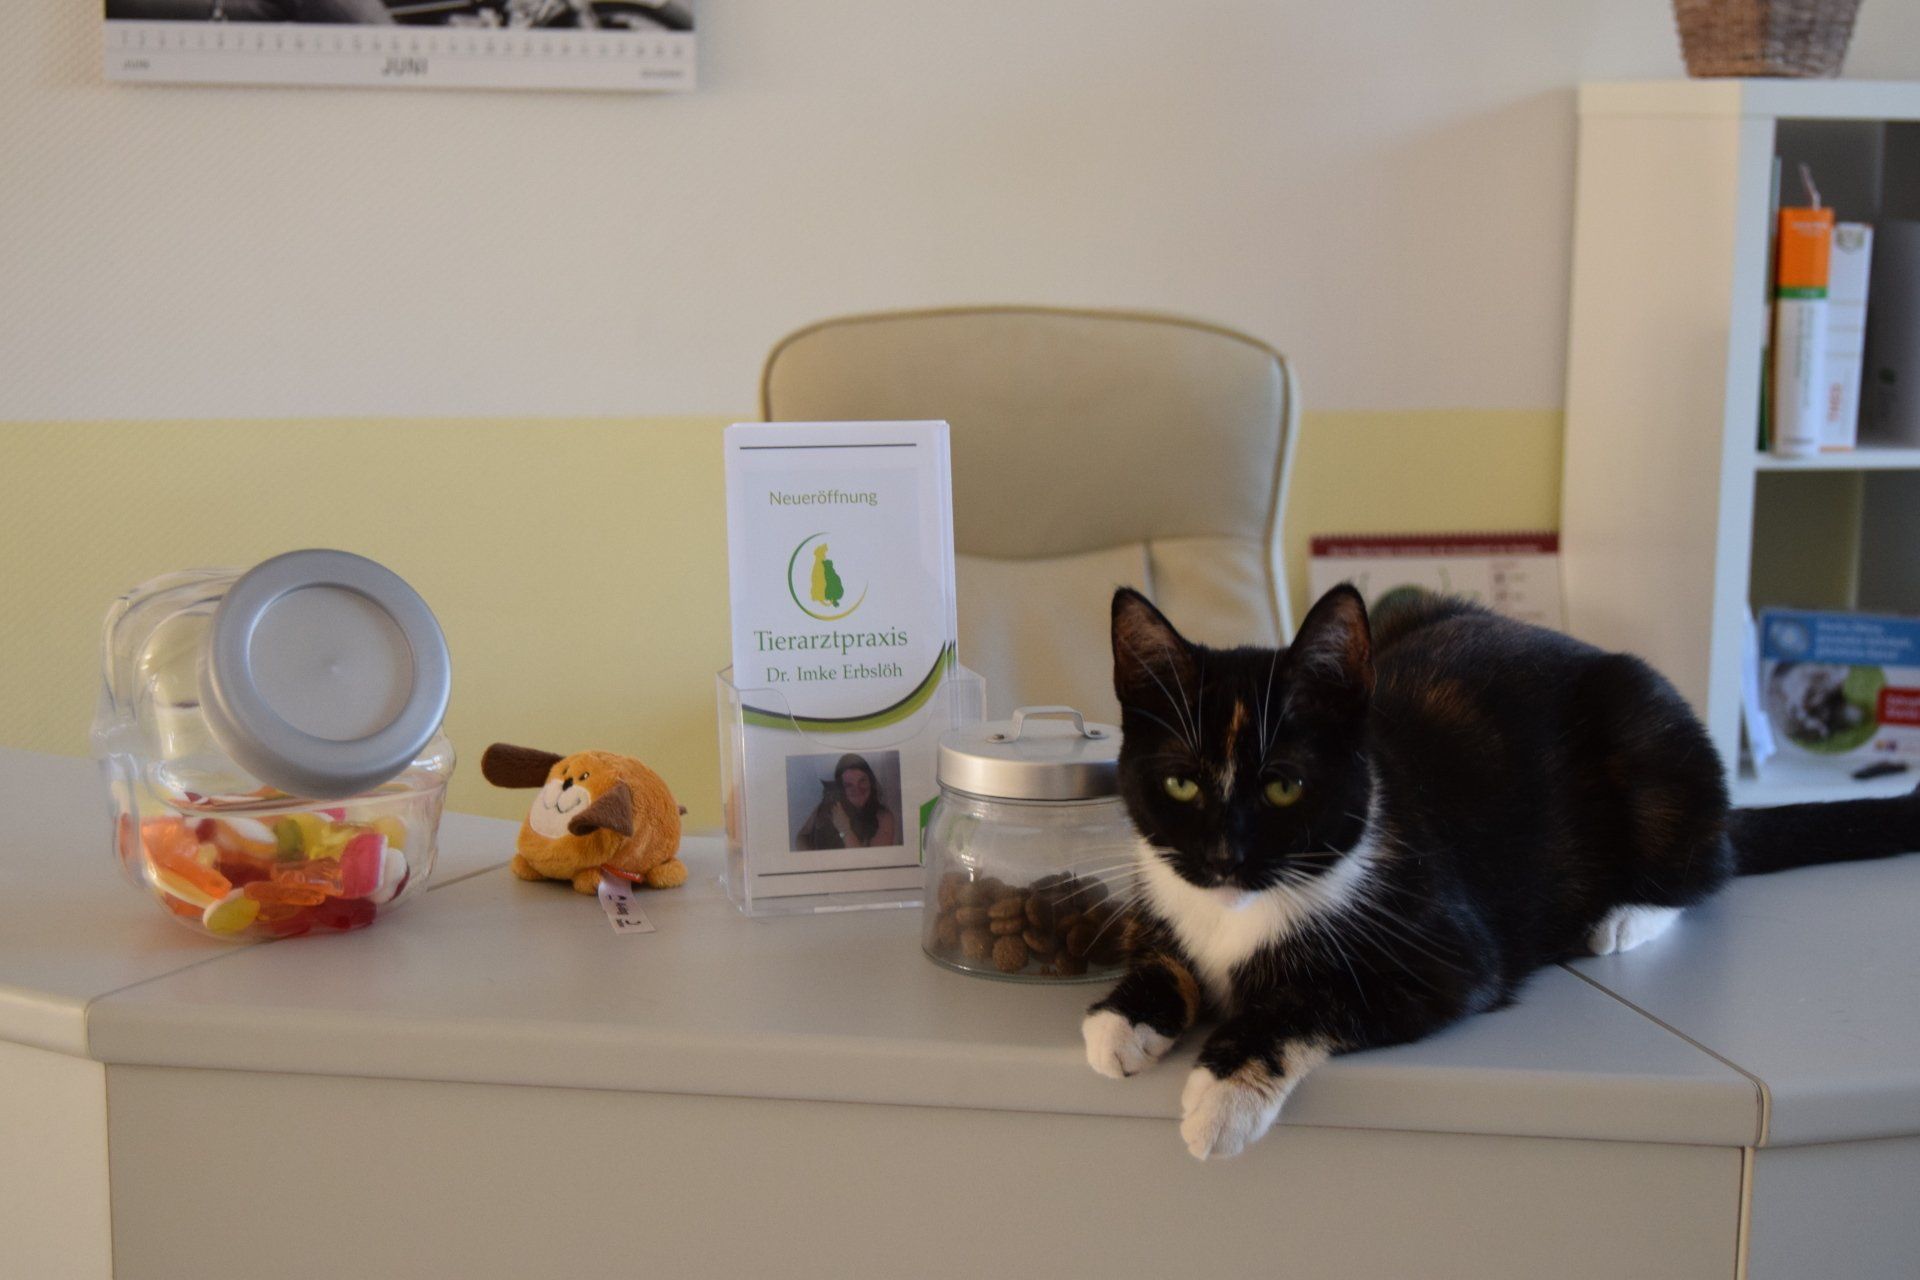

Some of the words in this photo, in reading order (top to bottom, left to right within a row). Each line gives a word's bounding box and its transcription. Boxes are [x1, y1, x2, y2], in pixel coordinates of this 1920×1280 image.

[382, 56, 428, 77] JUNI
[769, 490, 878, 507] Neueröffnung
[754, 627, 908, 655] Tierarztpraxis
[767, 667, 790, 683] Dr.
[797, 664, 837, 681] Imke
[842, 662, 903, 680] Erbslöh
